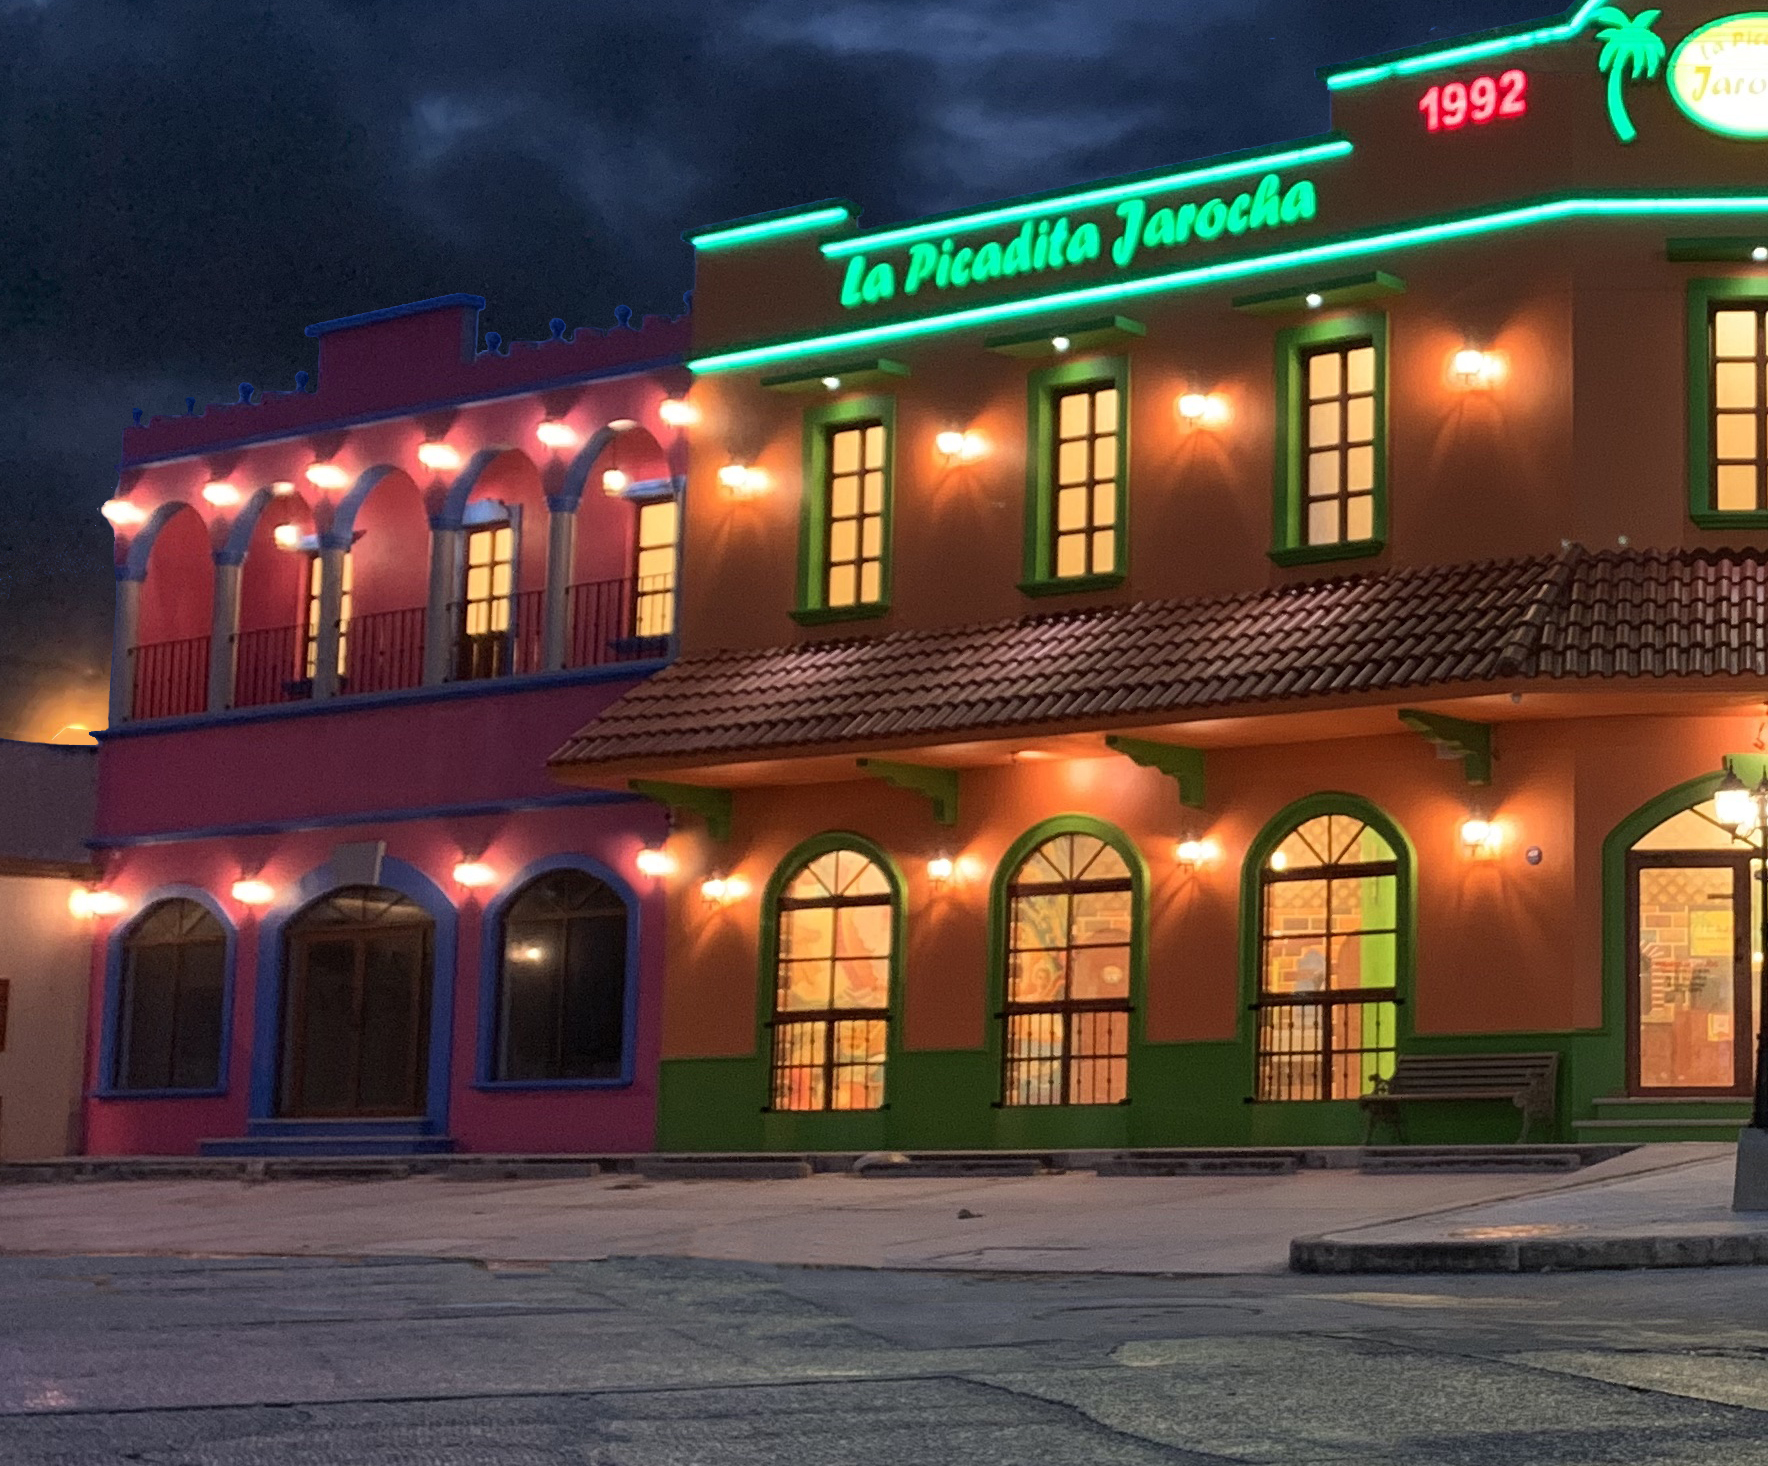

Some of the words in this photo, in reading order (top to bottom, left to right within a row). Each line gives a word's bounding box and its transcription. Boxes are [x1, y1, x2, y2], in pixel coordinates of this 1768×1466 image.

[1418, 69, 1527, 132] 1992
[840, 255, 895, 307] La
[904, 217, 1100, 295] Picadita
[1112, 174, 1316, 267] Jarocha
